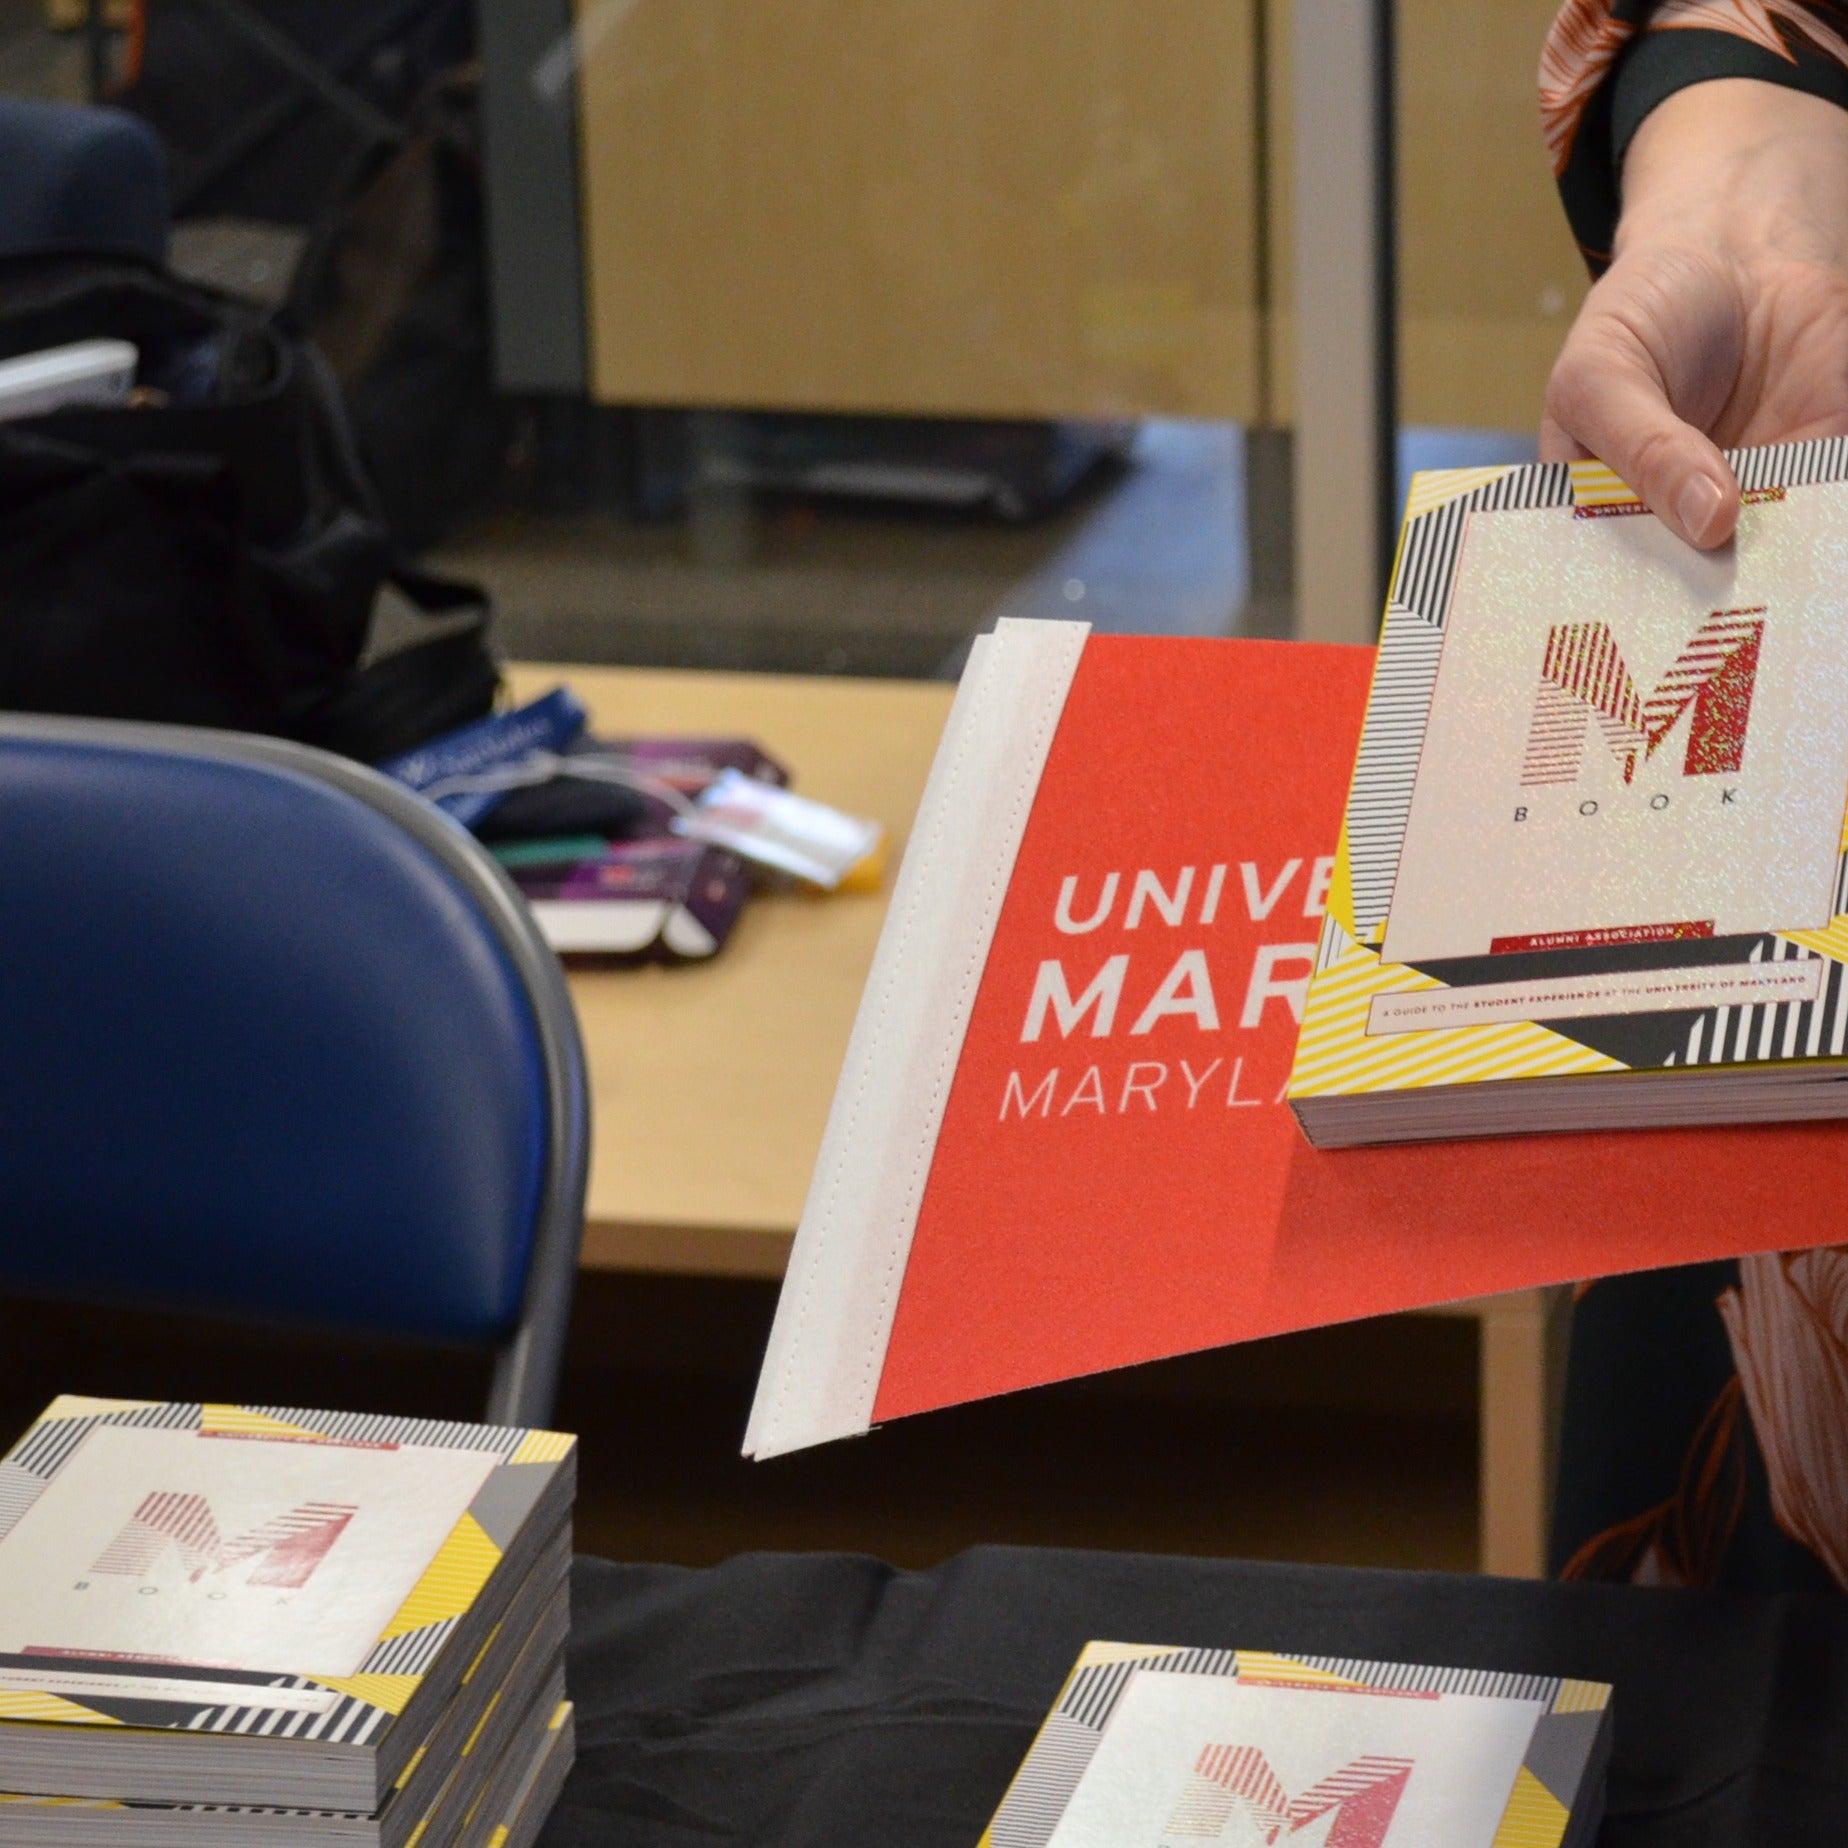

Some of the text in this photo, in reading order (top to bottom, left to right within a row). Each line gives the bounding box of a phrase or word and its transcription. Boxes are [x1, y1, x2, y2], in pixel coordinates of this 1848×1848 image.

[1520, 605, 1767, 786] M
[1514, 788, 1737, 823] BOOK
[1529, 926, 1675, 947] ALUMNI ASSOCIATION
[1020, 943, 1321, 1043] MAR
[1393, 1006, 1428, 1017] GUIDE
[1432, 1004, 1447, 1013] TO
[1451, 1002, 1470, 1011] THE
[1474, 997, 1526, 1009] STUDENT
[1529, 991, 1601, 1004] EXPERIENCE
[1622, 987, 1641, 996] THE
[1646, 981, 1717, 994] UNIVERSITY
[1720, 980, 1736, 989] OF
[1740, 975, 1807, 988] MARYLAND
[88, 1491, 360, 1589] M
